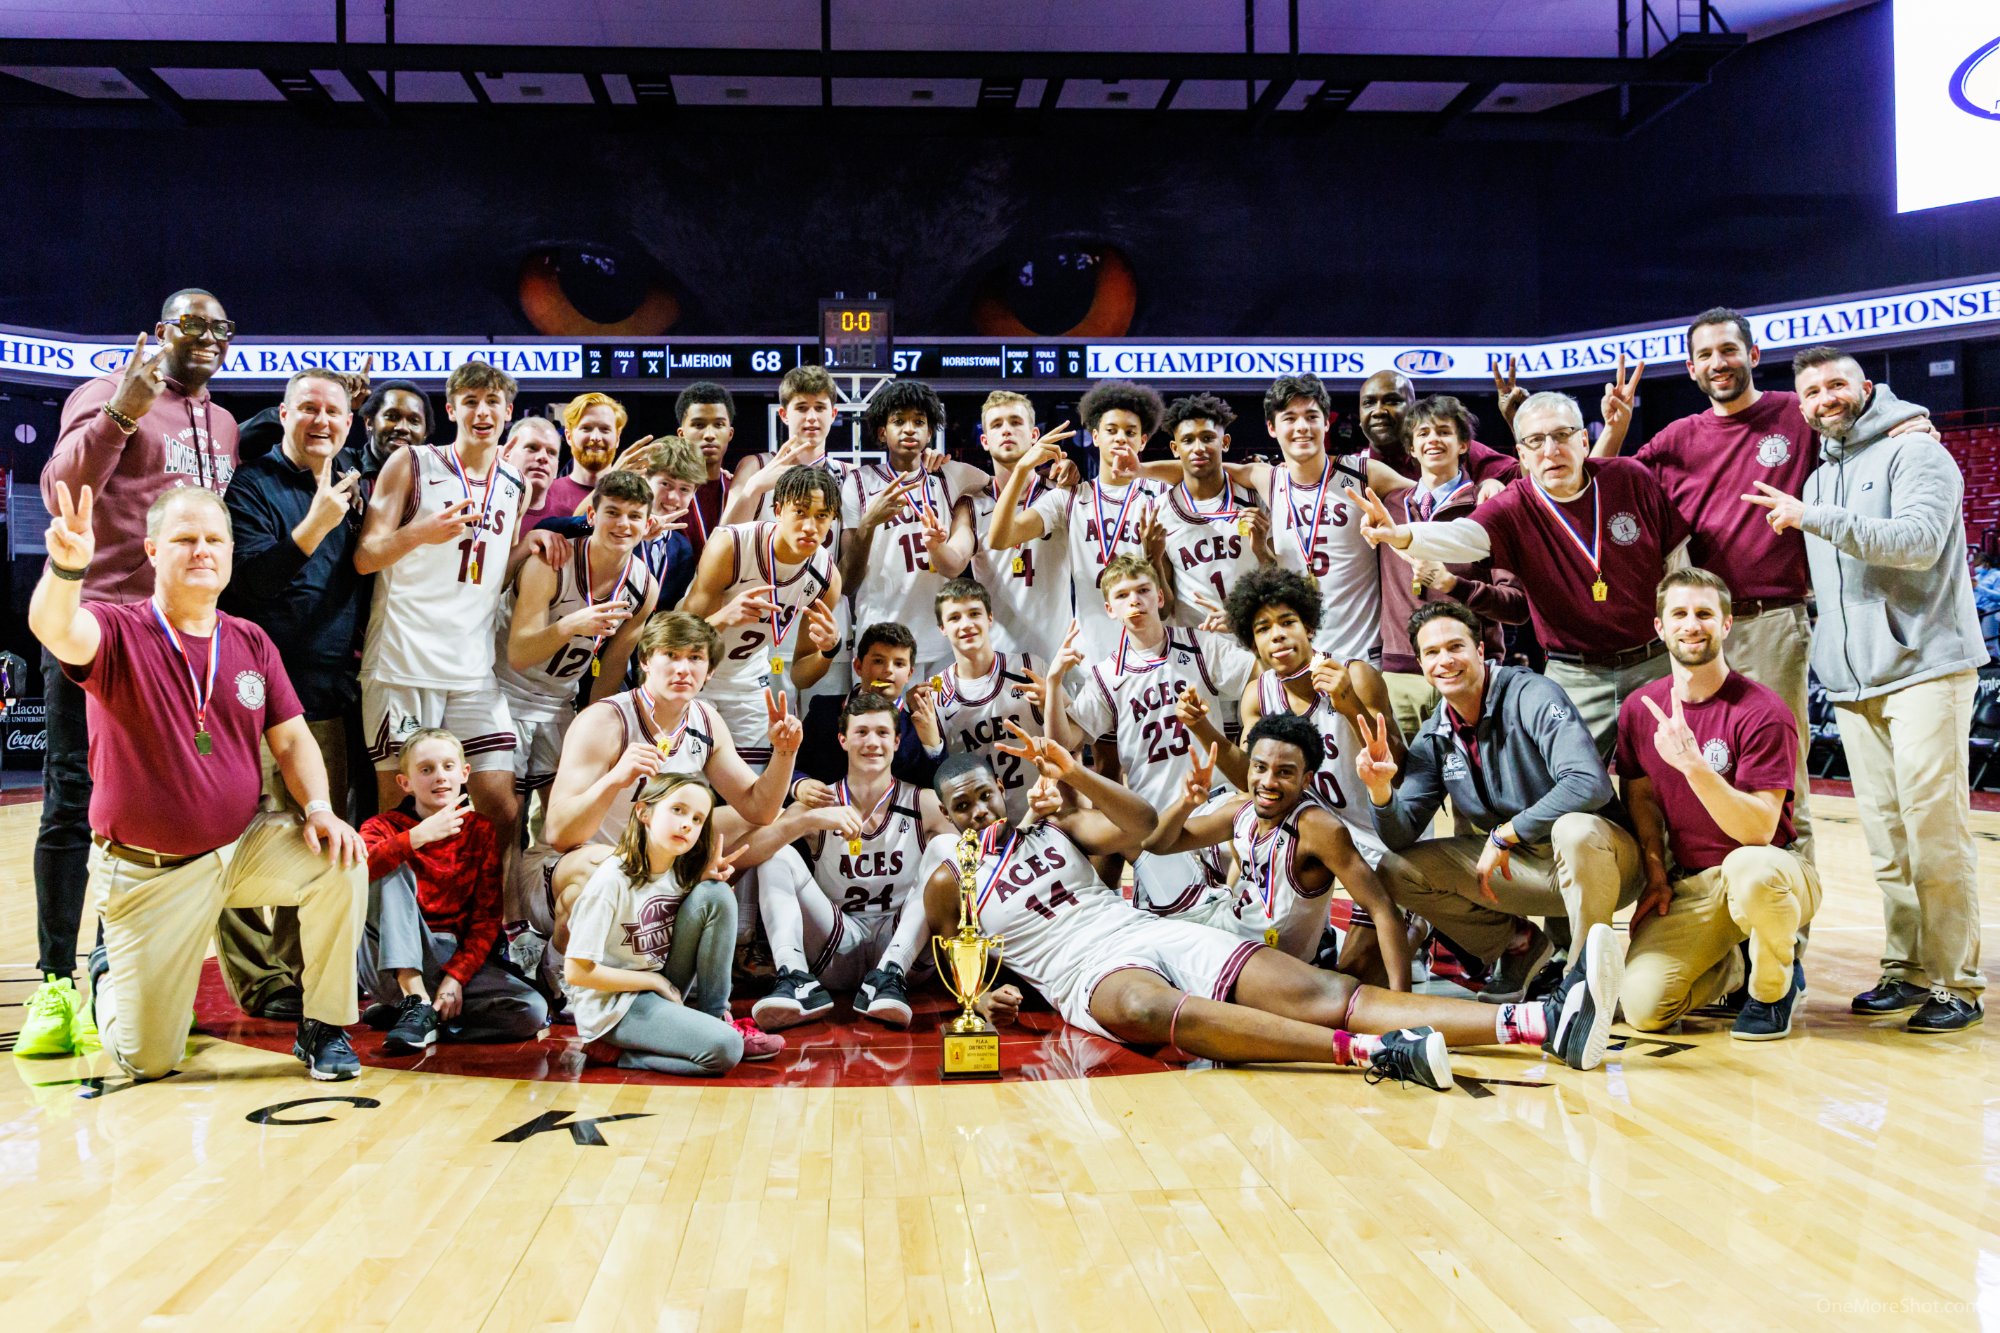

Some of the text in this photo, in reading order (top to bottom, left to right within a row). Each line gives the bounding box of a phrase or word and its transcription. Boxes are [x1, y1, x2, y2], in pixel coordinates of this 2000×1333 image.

[259, 351, 456, 372] BASKETBALL
[591, 361, 659, 374] 2 7 X
[670, 351, 782, 372] L.MERION 68
[893, 351, 922, 372] 57
[942, 356, 1001, 367] NORRISTOWN
[1007, 351, 1080, 359] BONUS FOULS TOL
[1012, 361, 1079, 374] X 10 0
[1115, 352, 1365, 373] CHAMPIONSHIPS
[1486, 349, 1556, 373] PIAA
[458, 538, 486, 585] 11
[898, 532, 931, 574] 15
[1178, 534, 1242, 572] ACES
[1209, 570, 1227, 600] 1
[545, 642, 592, 678] 12
[727, 630, 766, 661] 2
[1129, 679, 1188, 724] ACES
[960, 714, 1022, 753] ACES
[1142, 714, 1191, 764] 23
[1710, 752, 1720, 763] 14
[839, 850, 904, 880] ACES
[995, 846, 1067, 904] ACES
[841, 883, 895, 914] 24
[1025, 880, 1080, 921] 14
